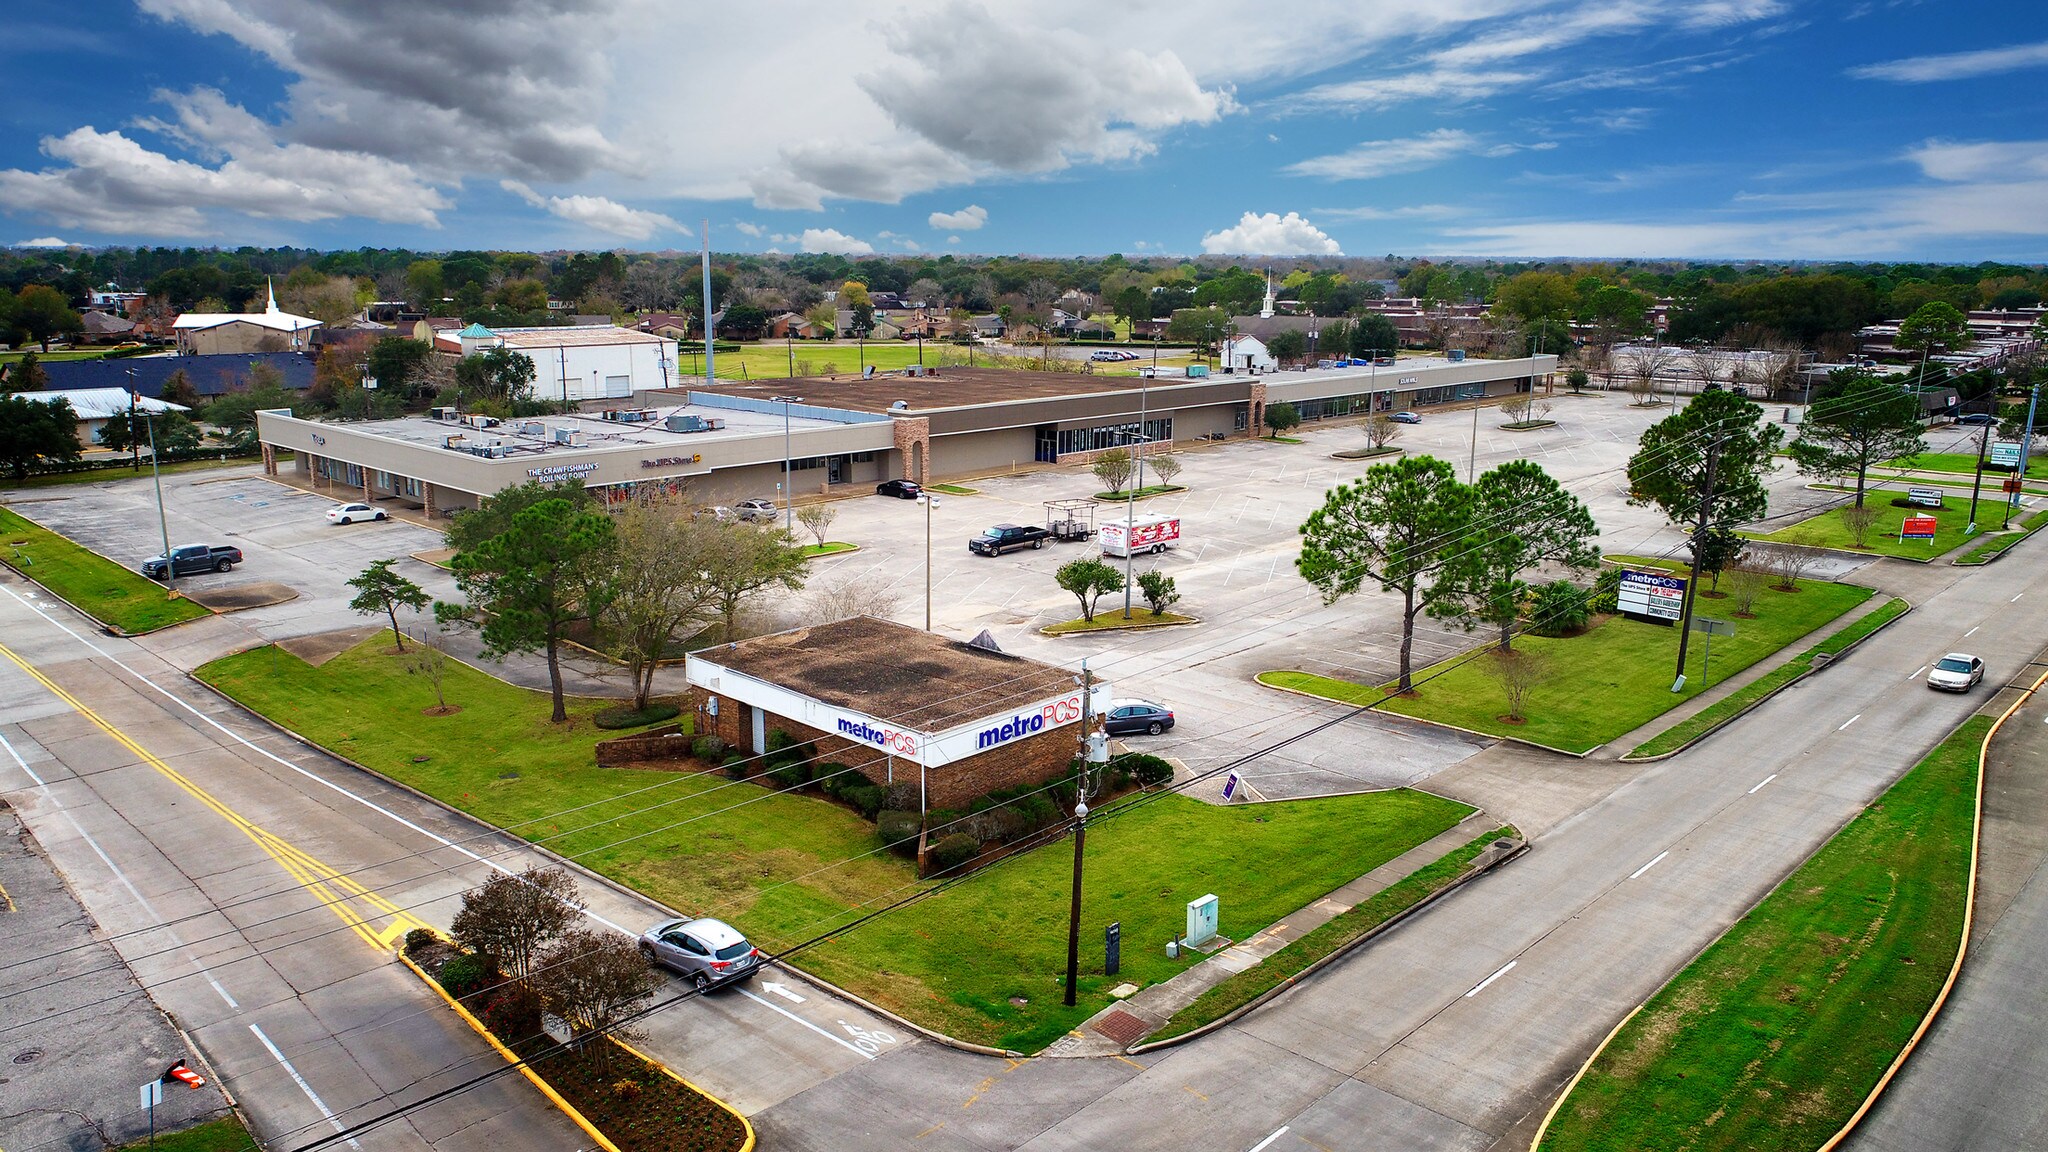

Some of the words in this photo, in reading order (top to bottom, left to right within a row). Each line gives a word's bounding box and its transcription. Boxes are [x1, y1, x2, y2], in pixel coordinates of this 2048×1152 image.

[527, 469, 542, 477] THE
[543, 462, 600, 475] CRAWFISHMAN'S
[538, 473, 567, 483] BOILING
[568, 471, 590, 480] POINT
[1627, 574, 1678, 588] metroPCS
[979, 697, 1080, 750] metroPCS
[837, 717, 917, 756] metroPCS
